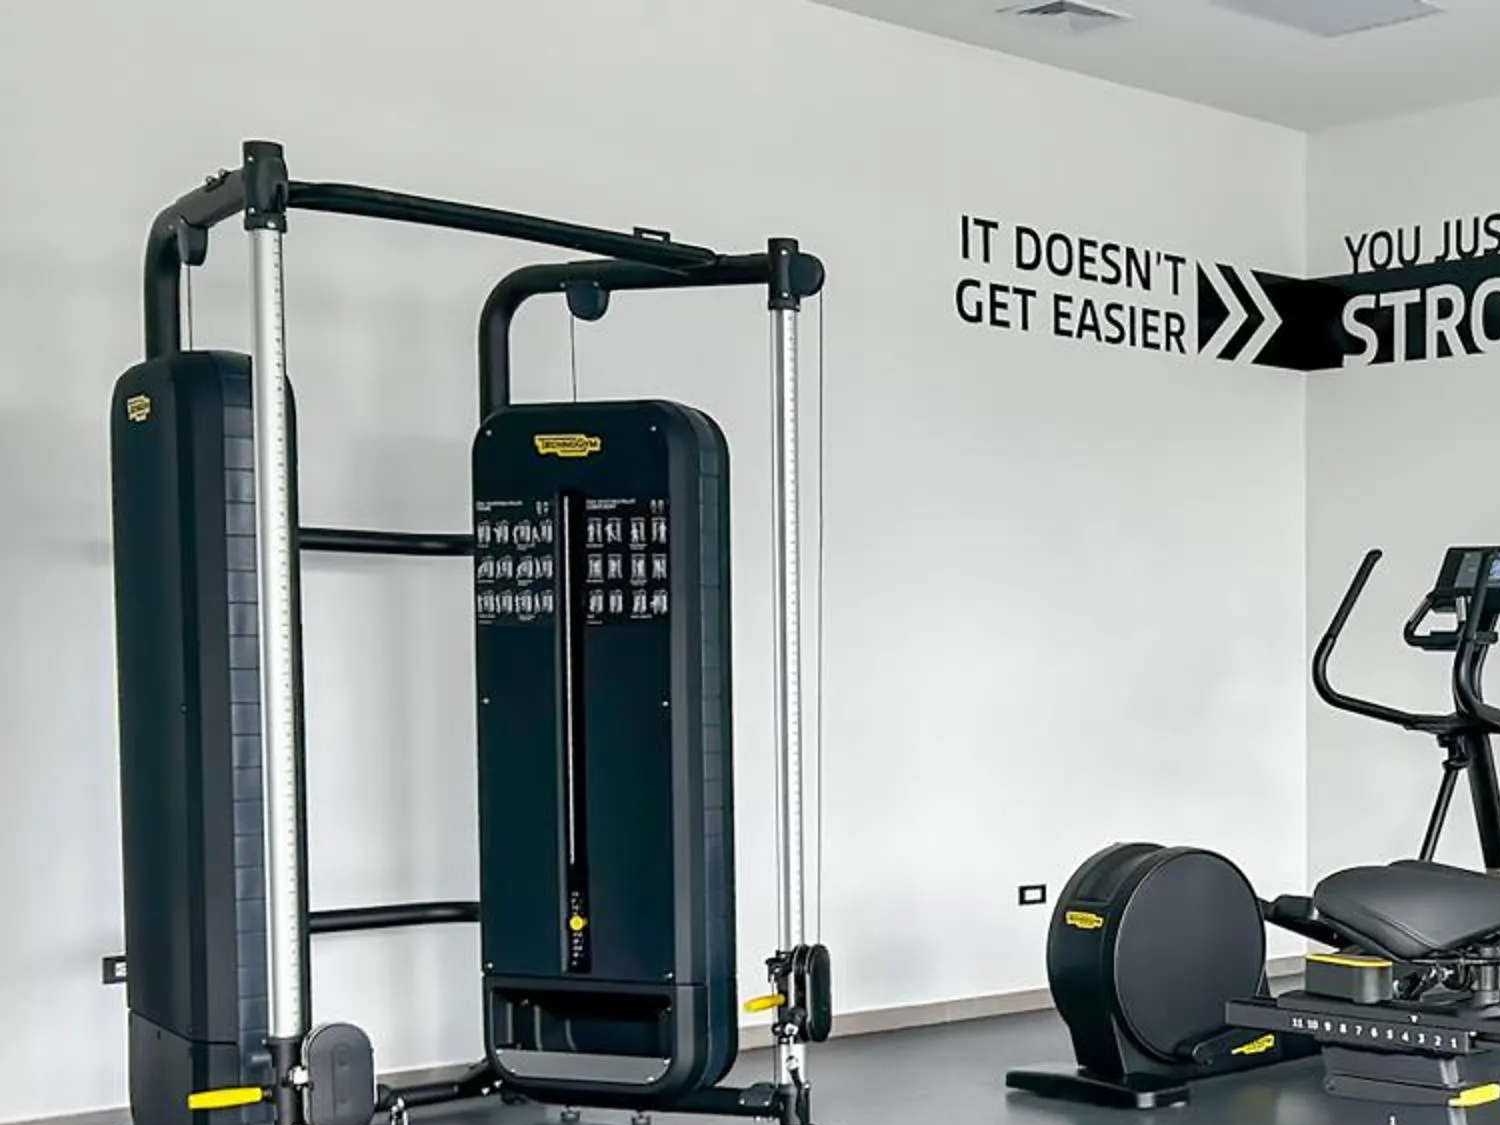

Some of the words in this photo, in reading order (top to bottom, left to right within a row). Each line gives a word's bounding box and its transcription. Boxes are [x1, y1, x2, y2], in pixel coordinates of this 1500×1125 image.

[961, 215, 999, 263] IT
[1015, 225, 1187, 296] DOESN'T
[1344, 225, 1421, 274] YOU
[955, 278, 1037, 331] GET
[1053, 293, 1186, 354] EASIER
[1355, 1025, 1363, 1036] 7
[1370, 1027, 1378, 1038] 6
[1401, 1031, 1409, 1042] 4
[1418, 1033, 1425, 1044] 3
[1434, 1035, 1442, 1047] 2
[1450, 1037, 1457, 1049] 1
